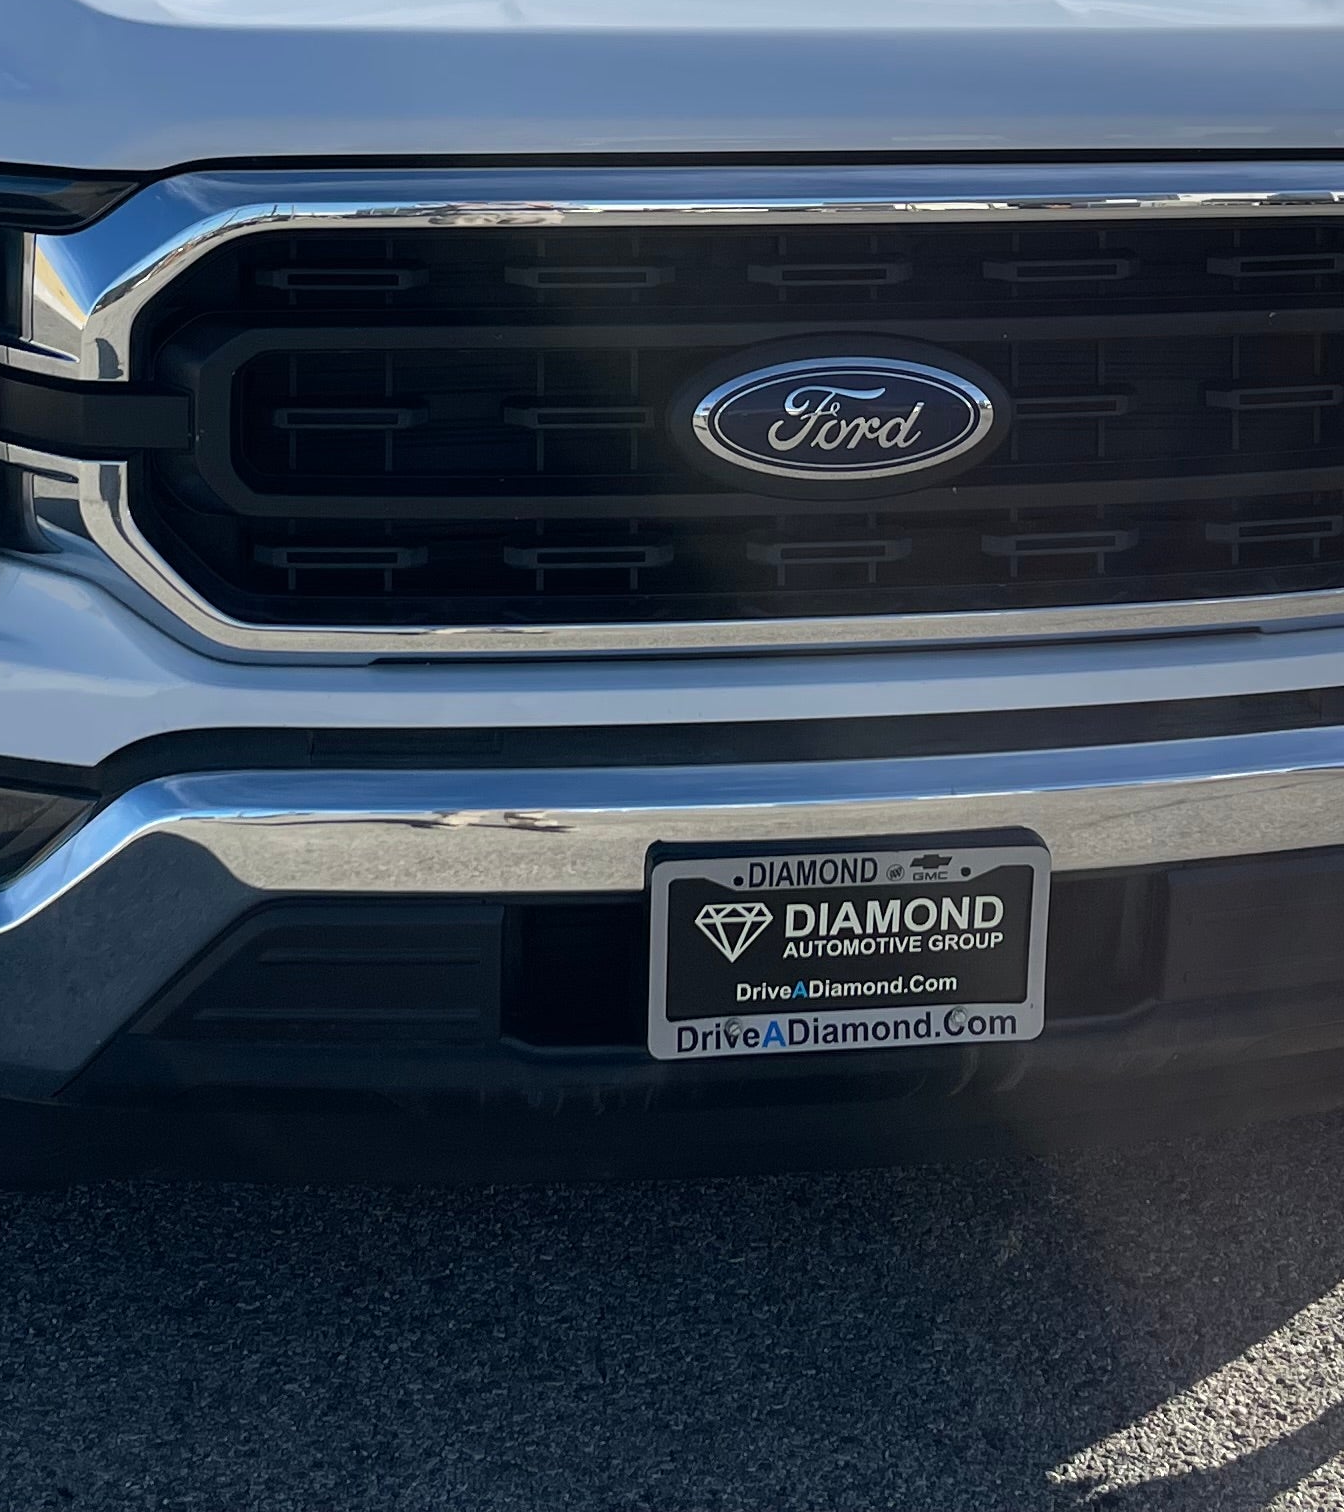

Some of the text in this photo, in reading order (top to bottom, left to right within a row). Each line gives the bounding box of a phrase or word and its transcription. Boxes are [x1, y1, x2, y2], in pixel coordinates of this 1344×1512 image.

[767, 385, 925, 451] Ford
[749, 857, 948, 888] DIAMOND GMC
[785, 896, 1004, 938] DIAMOND
[783, 932, 1004, 959] AUTOMOTIVE GROUP
[736, 975, 957, 1002] DriveADiamond.Com
[677, 1011, 1017, 1053] DriveADiamond.Com
